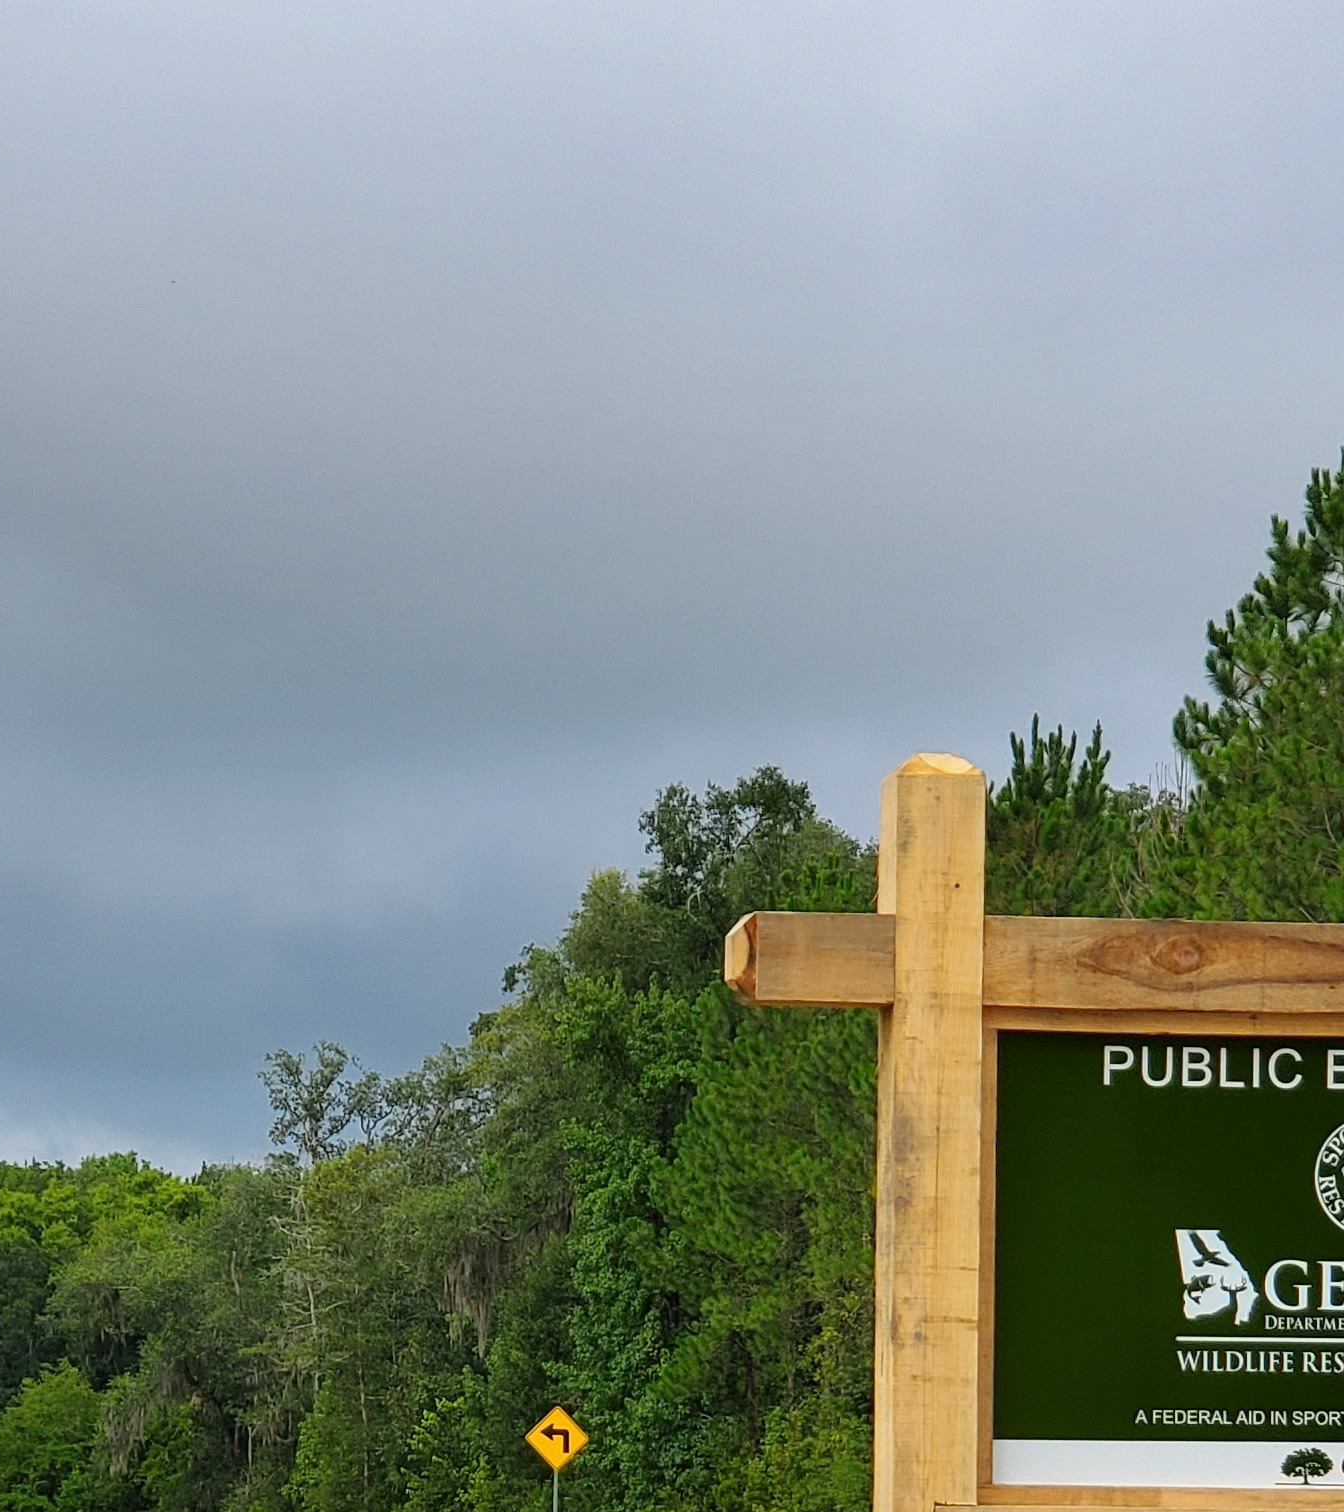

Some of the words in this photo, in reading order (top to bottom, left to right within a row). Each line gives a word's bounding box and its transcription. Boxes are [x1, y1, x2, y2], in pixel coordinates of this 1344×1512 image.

[1101, 1044, 1304, 1090] PUBLIC
[1176, 1350, 1294, 1373] WILDLIFE
[1134, 1409, 1148, 1425] A
[1152, 1409, 1233, 1426] FEDERAL
[1235, 1410, 1266, 1426] AID
[1270, 1410, 1287, 1426] IN
